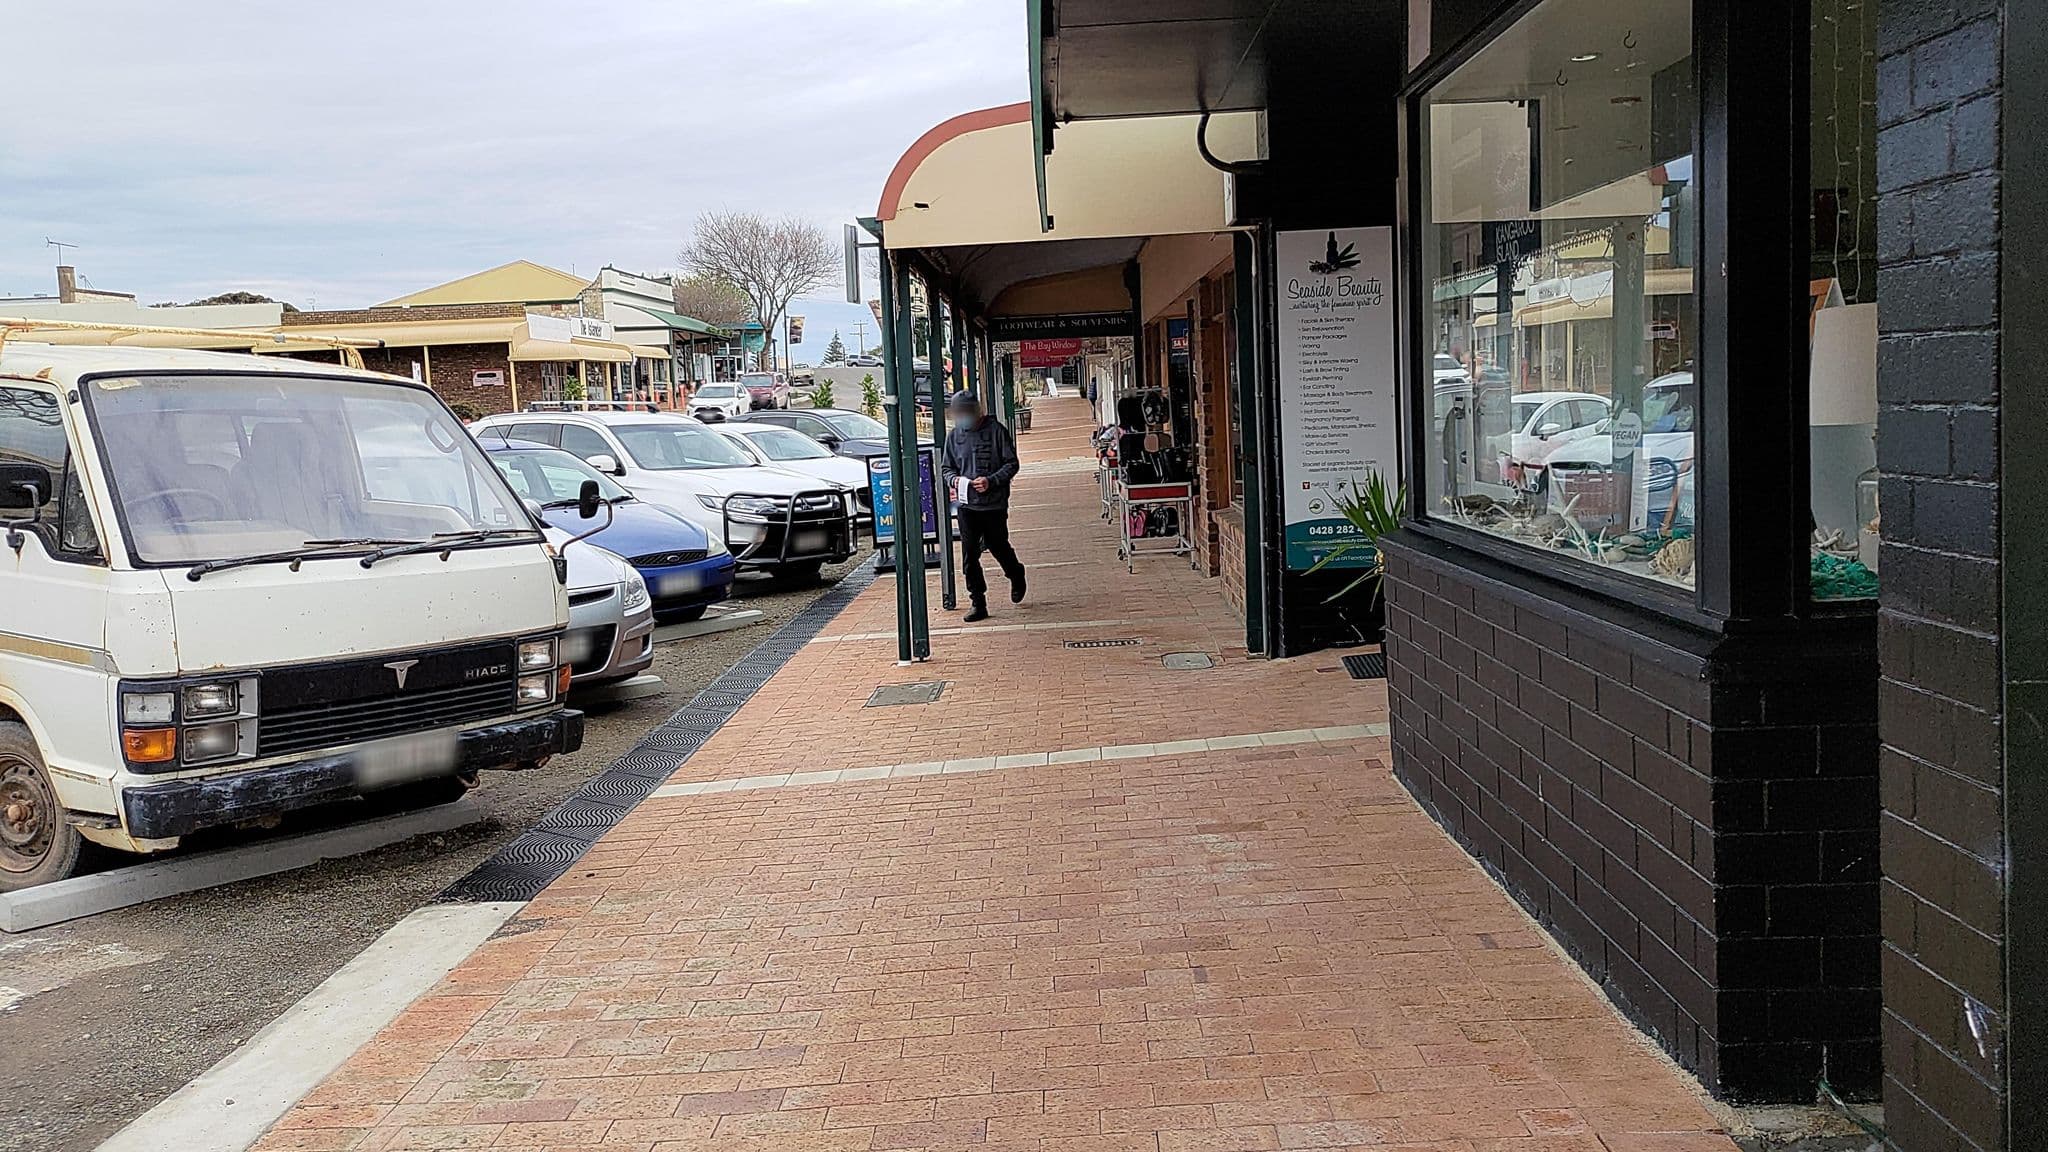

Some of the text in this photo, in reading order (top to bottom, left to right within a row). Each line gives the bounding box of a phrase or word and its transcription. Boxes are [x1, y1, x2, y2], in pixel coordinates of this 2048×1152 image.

[1496, 239, 1520, 263] ISLAND
[1287, 275, 1384, 306] Seaside Beauty
[588, 320, 602, 337] Islander
[1000, 317, 1127, 330] FOOTWEAR & SOUVENIRS
[1024, 340, 1077, 352] The Bay Window
[1612, 430, 1640, 440] VEGAN
[1327, 460, 1346, 468] organic
[1309, 526, 1334, 535] 0428
[1336, 525, 1355, 534] 282
[465, 664, 507, 678] HIACE
